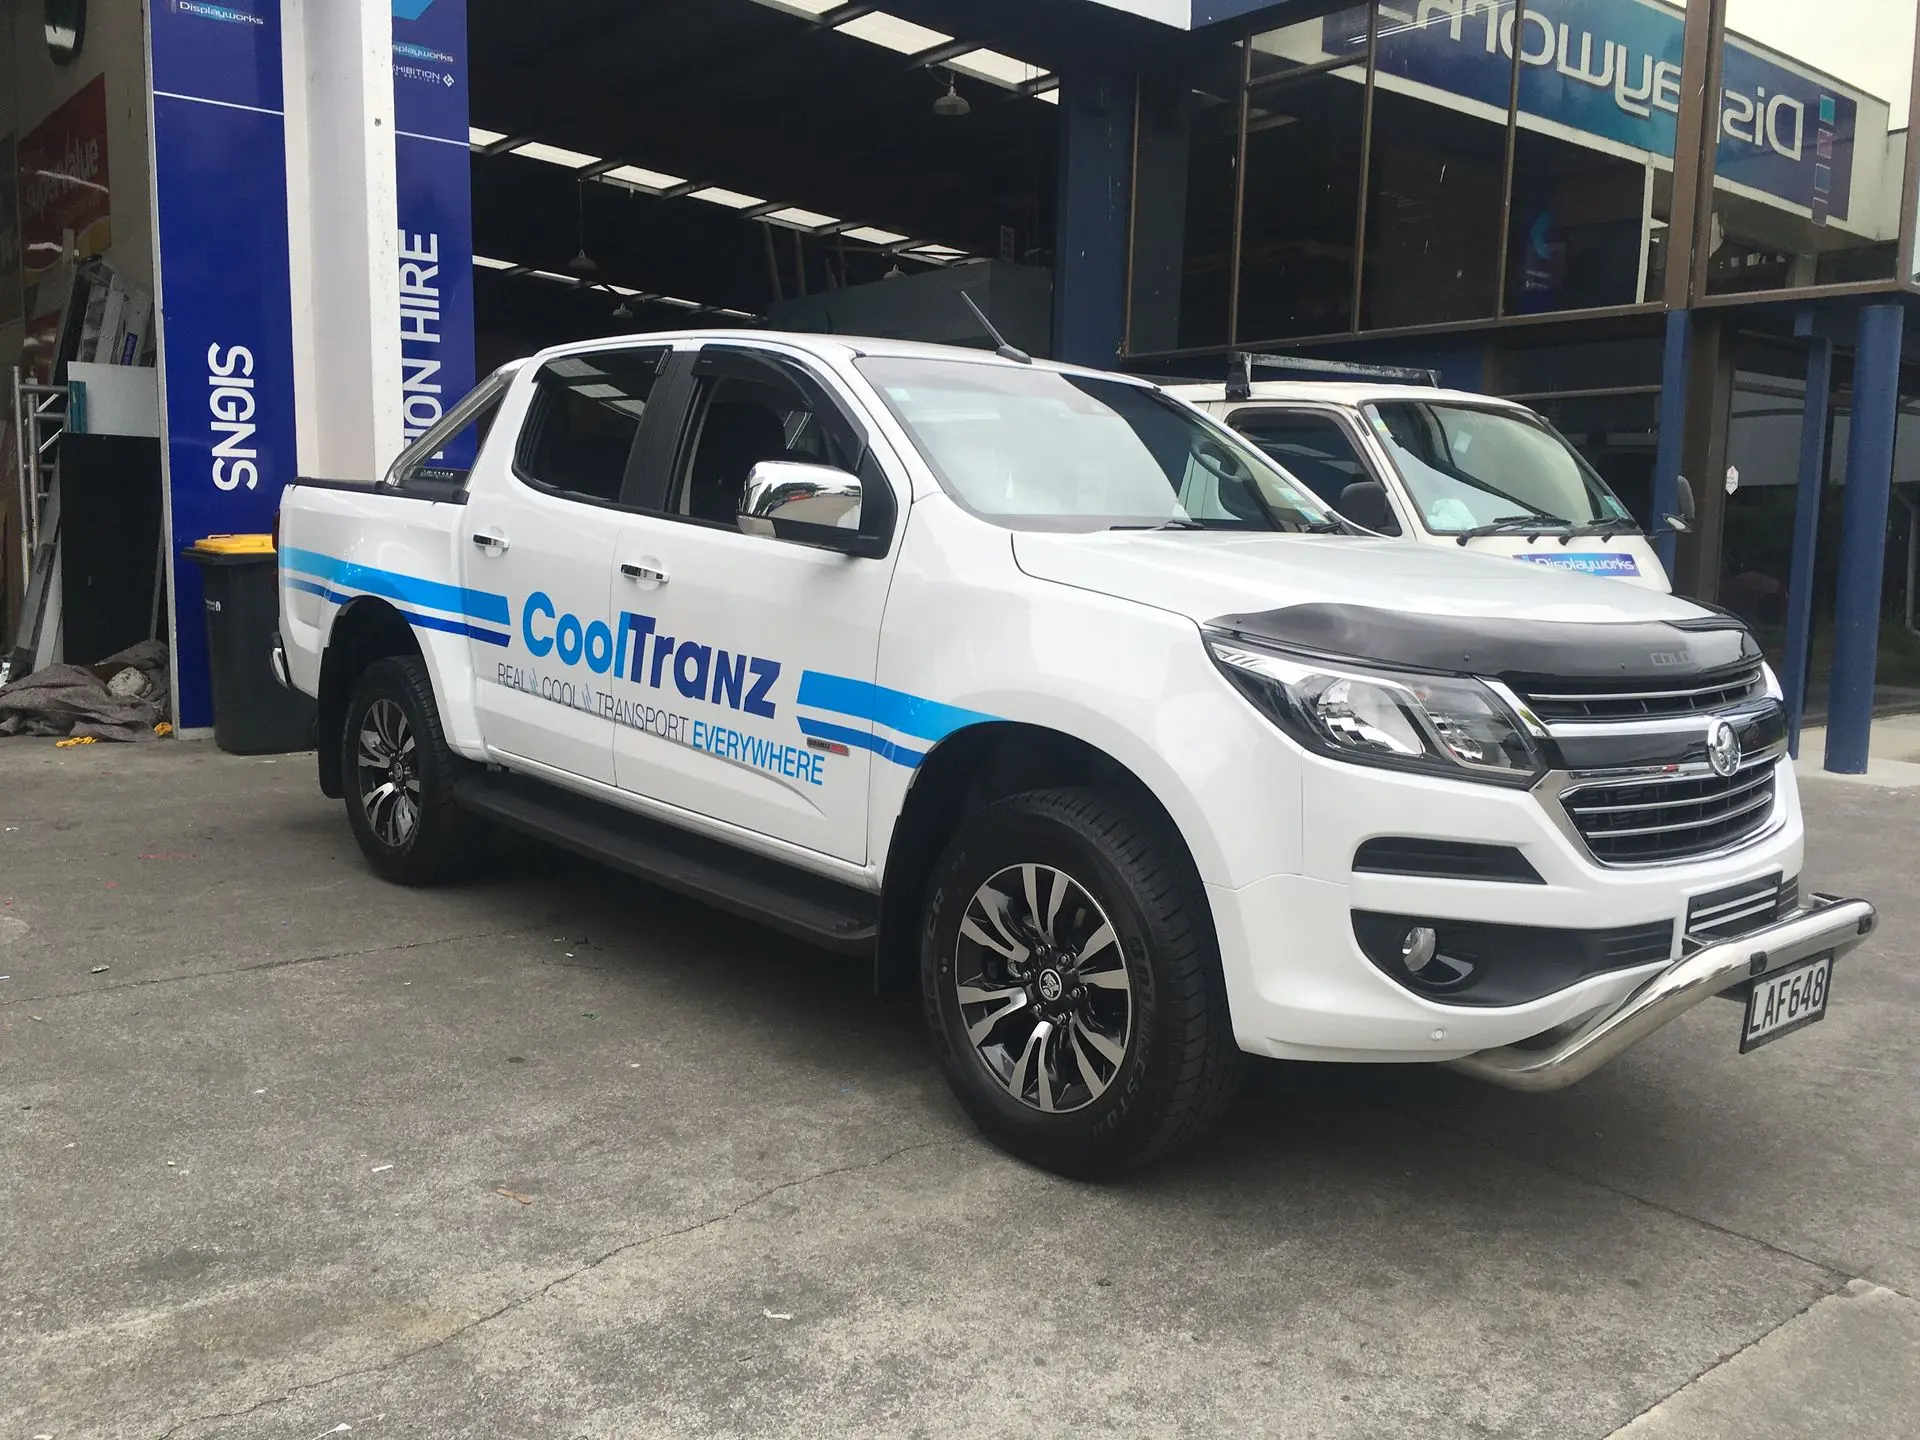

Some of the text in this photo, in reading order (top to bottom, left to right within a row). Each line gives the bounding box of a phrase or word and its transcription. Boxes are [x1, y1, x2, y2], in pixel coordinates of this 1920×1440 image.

[179, 1, 264, 25] Displayworks
[399, 229, 440, 342] HIRE
[208, 342, 258, 491] SIGNS
[402, 358, 443, 459] ION
[1535, 558, 1635, 573] Displayworks
[497, 662, 530, 693] REAL
[542, 676, 582, 710] COOL
[596, 691, 689, 743] TRANSPORT
[692, 720, 826, 785] EVERYWHERE
[1749, 966, 1826, 1034] LAF648
